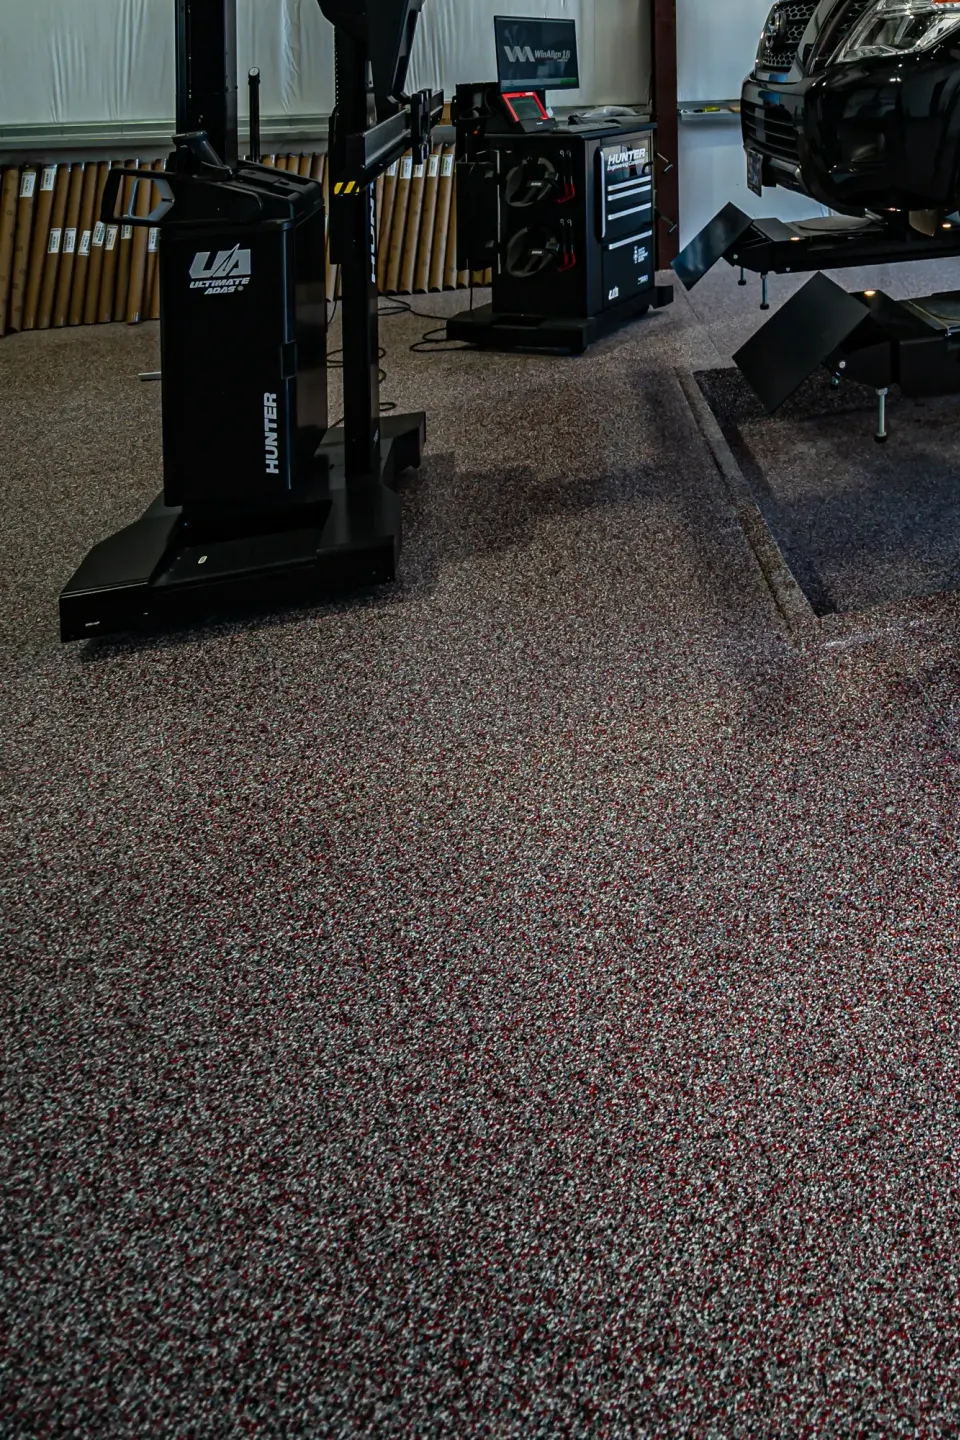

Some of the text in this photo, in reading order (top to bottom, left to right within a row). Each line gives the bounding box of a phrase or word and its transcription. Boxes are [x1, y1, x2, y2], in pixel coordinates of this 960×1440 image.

[534, 49, 562, 59] WinAlign
[607, 148, 646, 165] HUNTER
[189, 277, 251, 289] ULTIMATE
[263, 392, 279, 474] HUNTER
